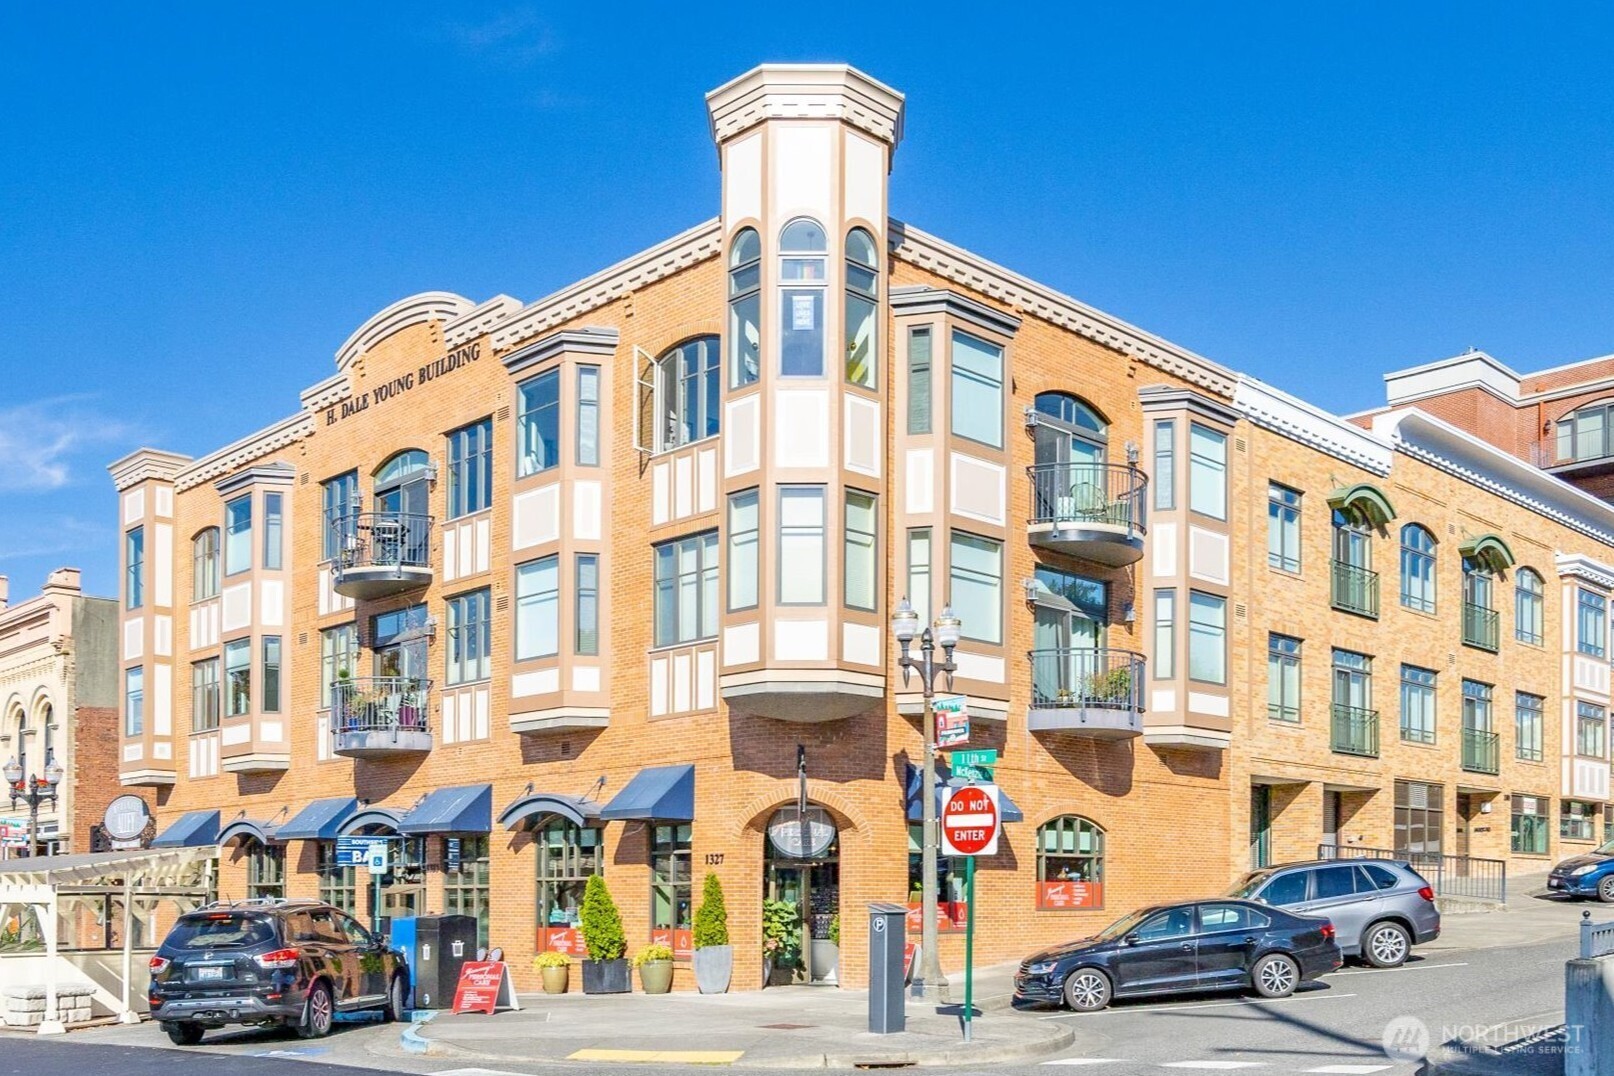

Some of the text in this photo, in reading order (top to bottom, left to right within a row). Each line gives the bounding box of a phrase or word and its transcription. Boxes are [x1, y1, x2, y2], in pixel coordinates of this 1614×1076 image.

[326, 342, 481, 426] H. DALE YOUNG BUILDING
[961, 754, 979, 764] 11th
[951, 799, 989, 812] DO NOT
[954, 830, 986, 841] ENTER
[705, 853, 725, 865] 1327
